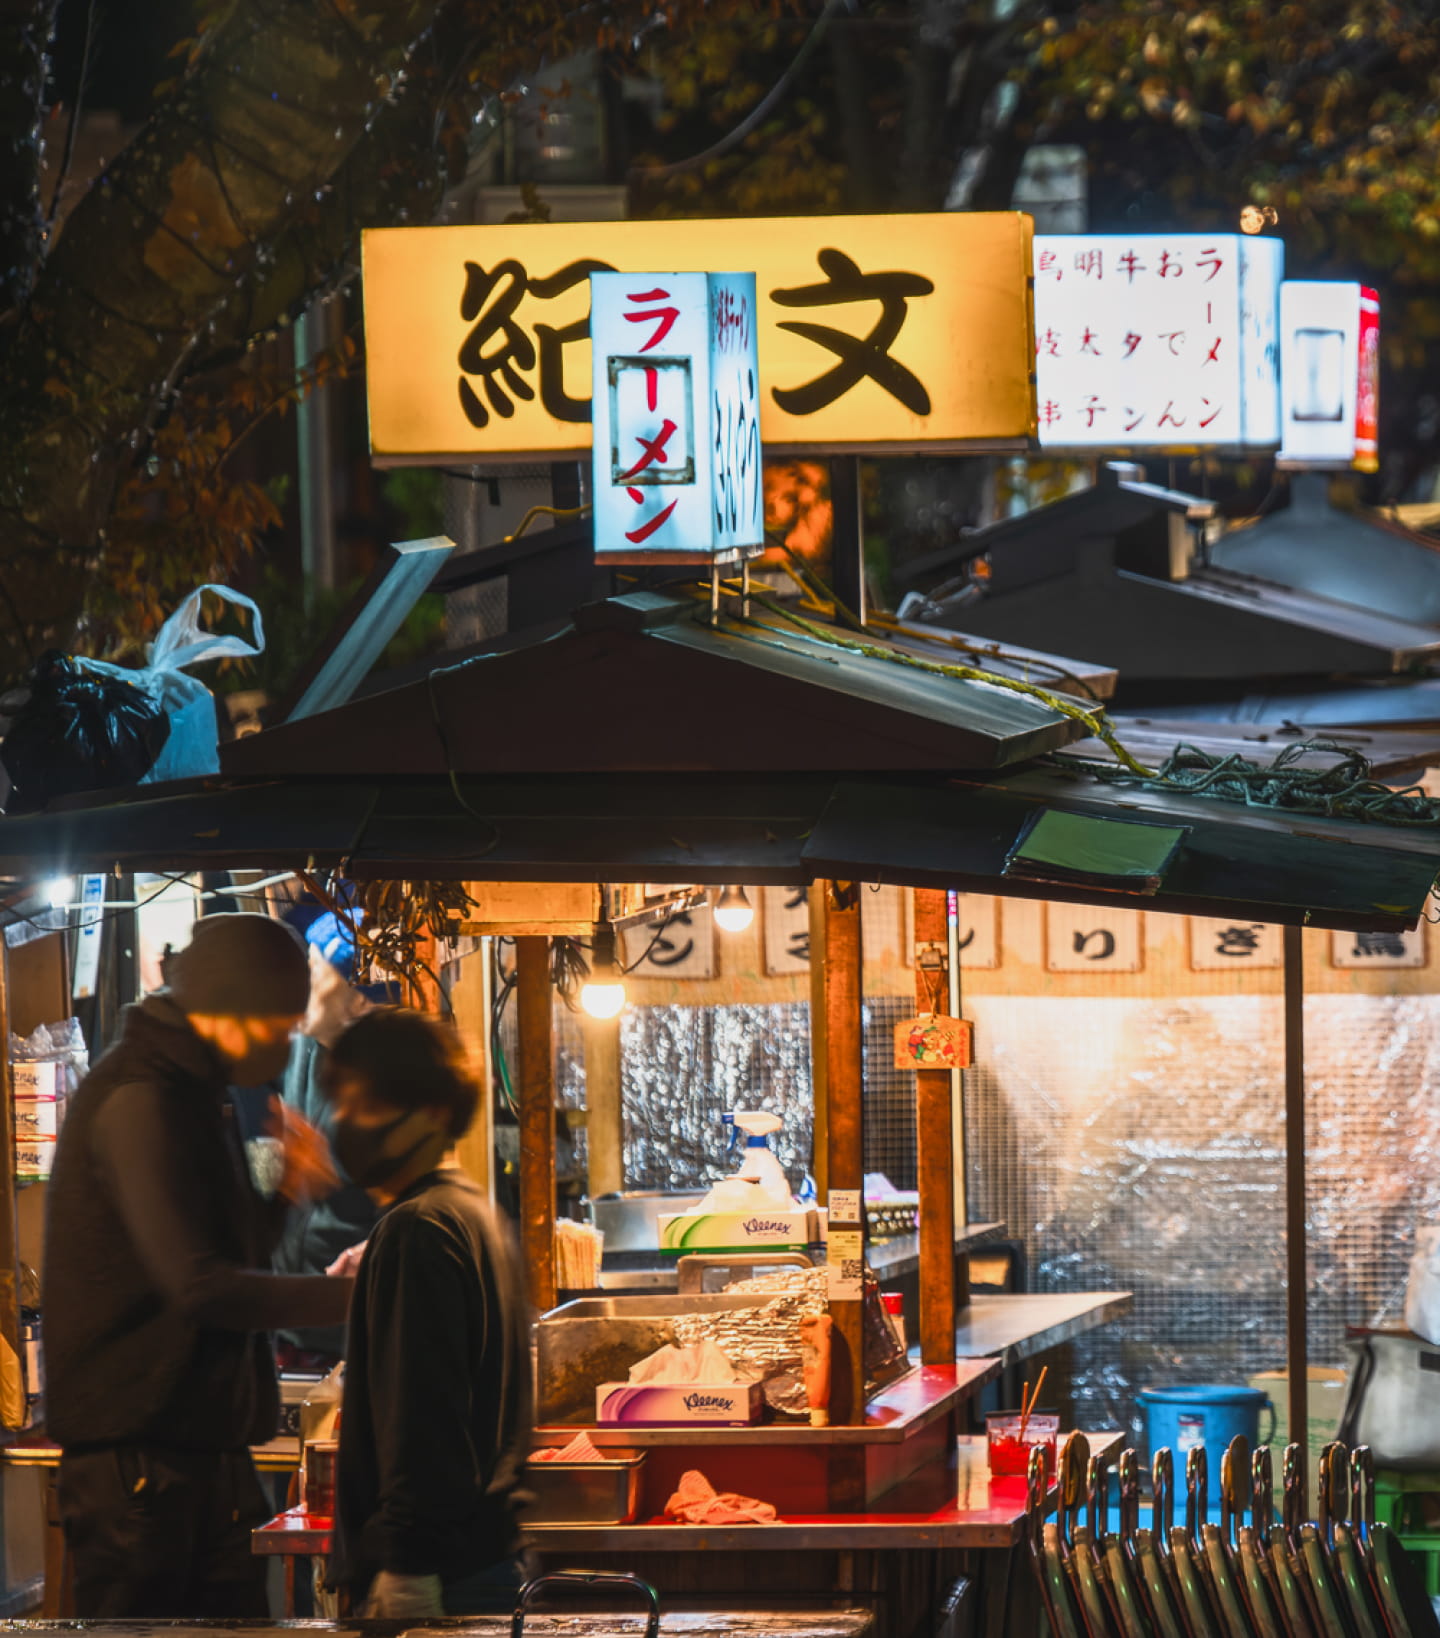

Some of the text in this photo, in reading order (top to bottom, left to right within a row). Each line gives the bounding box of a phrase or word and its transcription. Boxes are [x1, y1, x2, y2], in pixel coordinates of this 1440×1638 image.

[458, 247, 934, 428] 紀文
[619, 287, 681, 544] ラーメン
[1074, 248, 1107, 428] 明太子
[1115, 249, 1147, 432] 牛タン
[1157, 249, 1187, 428] おでん
[1196, 248, 1223, 428] ラーメン
[742, 1217, 792, 1236] Kleenex
[682, 1392, 734, 1411] Kleenex
